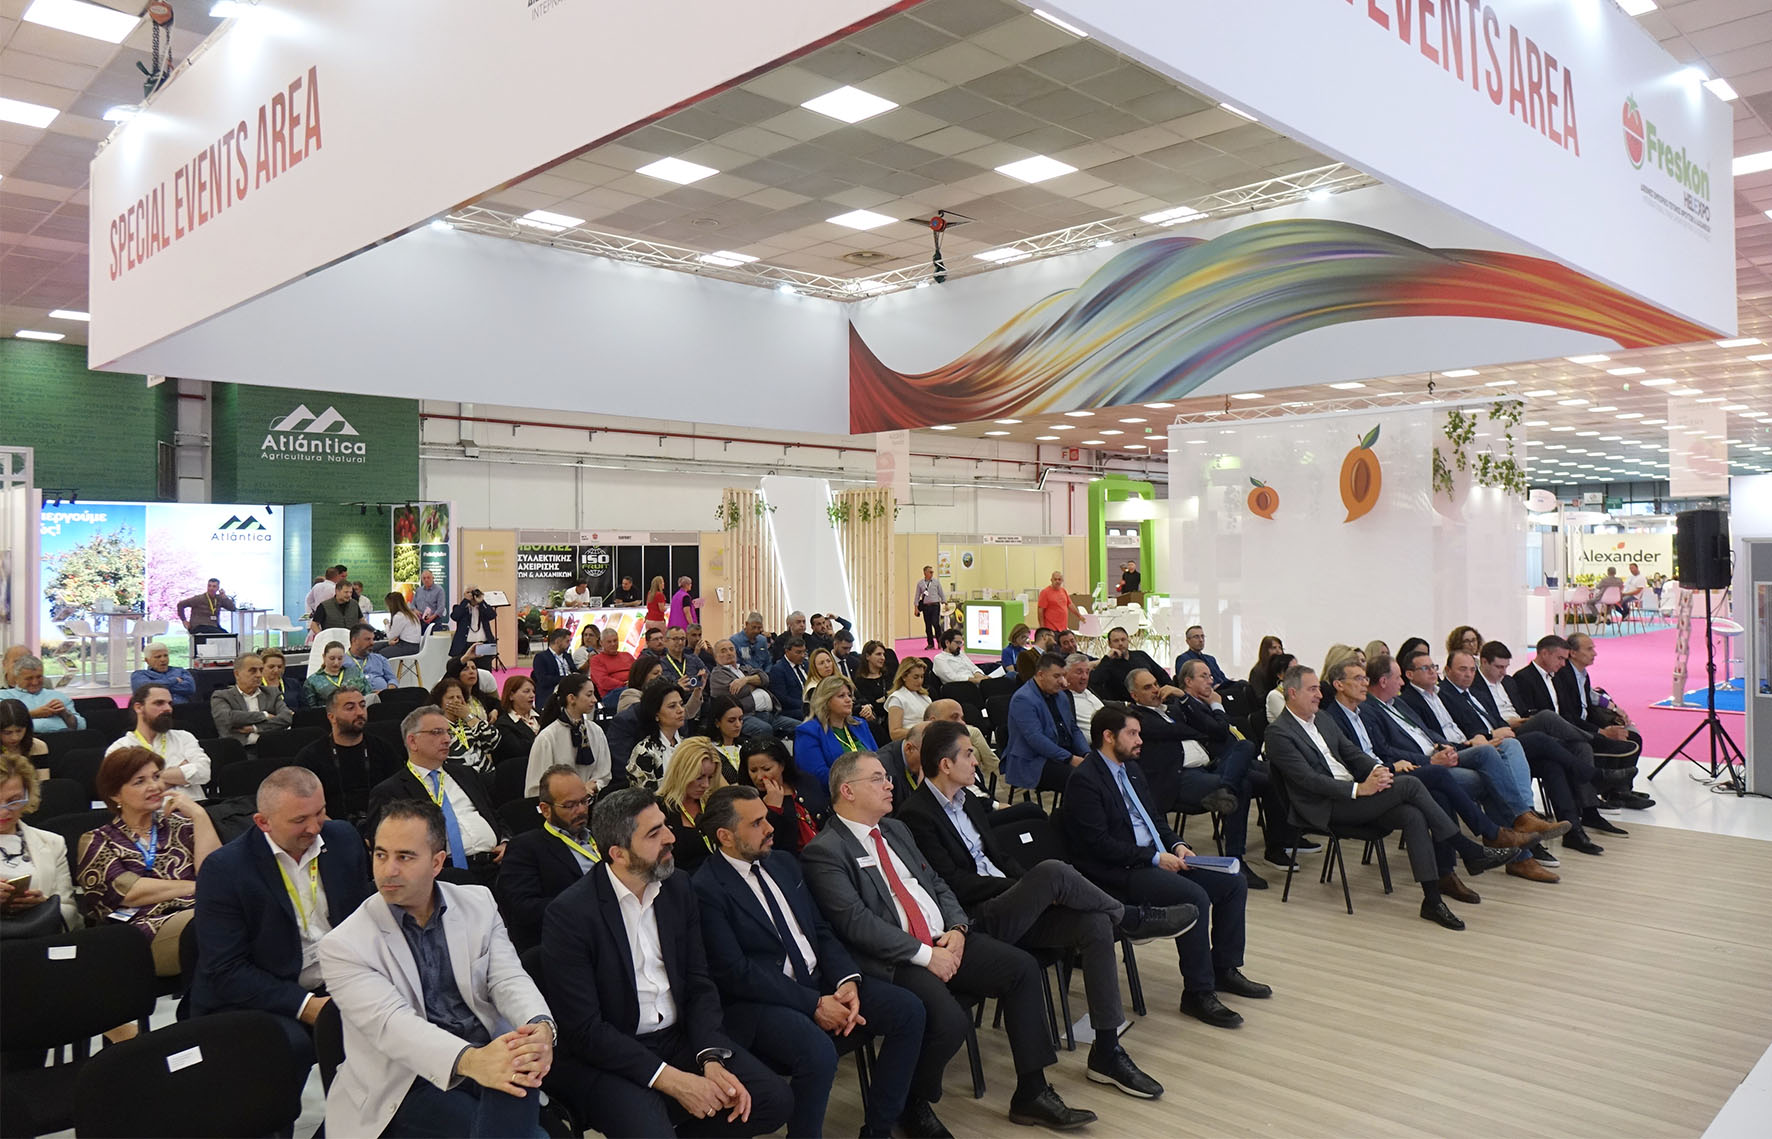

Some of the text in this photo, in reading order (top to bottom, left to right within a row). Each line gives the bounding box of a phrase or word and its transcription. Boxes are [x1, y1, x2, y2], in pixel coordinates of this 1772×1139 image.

[1368, 0, 1580, 157] ENTS AREA
[1646, 119, 1710, 202] Freskon
[110, 65, 322, 281] SPECIAL EVENTS AREA
[261, 434, 366, 455] Atlántica
[261, 452, 366, 463] Agricultura Natural
[211, 531, 272, 542] Atlántica
[517, 554, 572, 562] ΣΥΛΛΕΚΤΙΚΗΣ
[581, 554, 610, 564] ISO
[1579, 549, 1661, 563] Alexander
